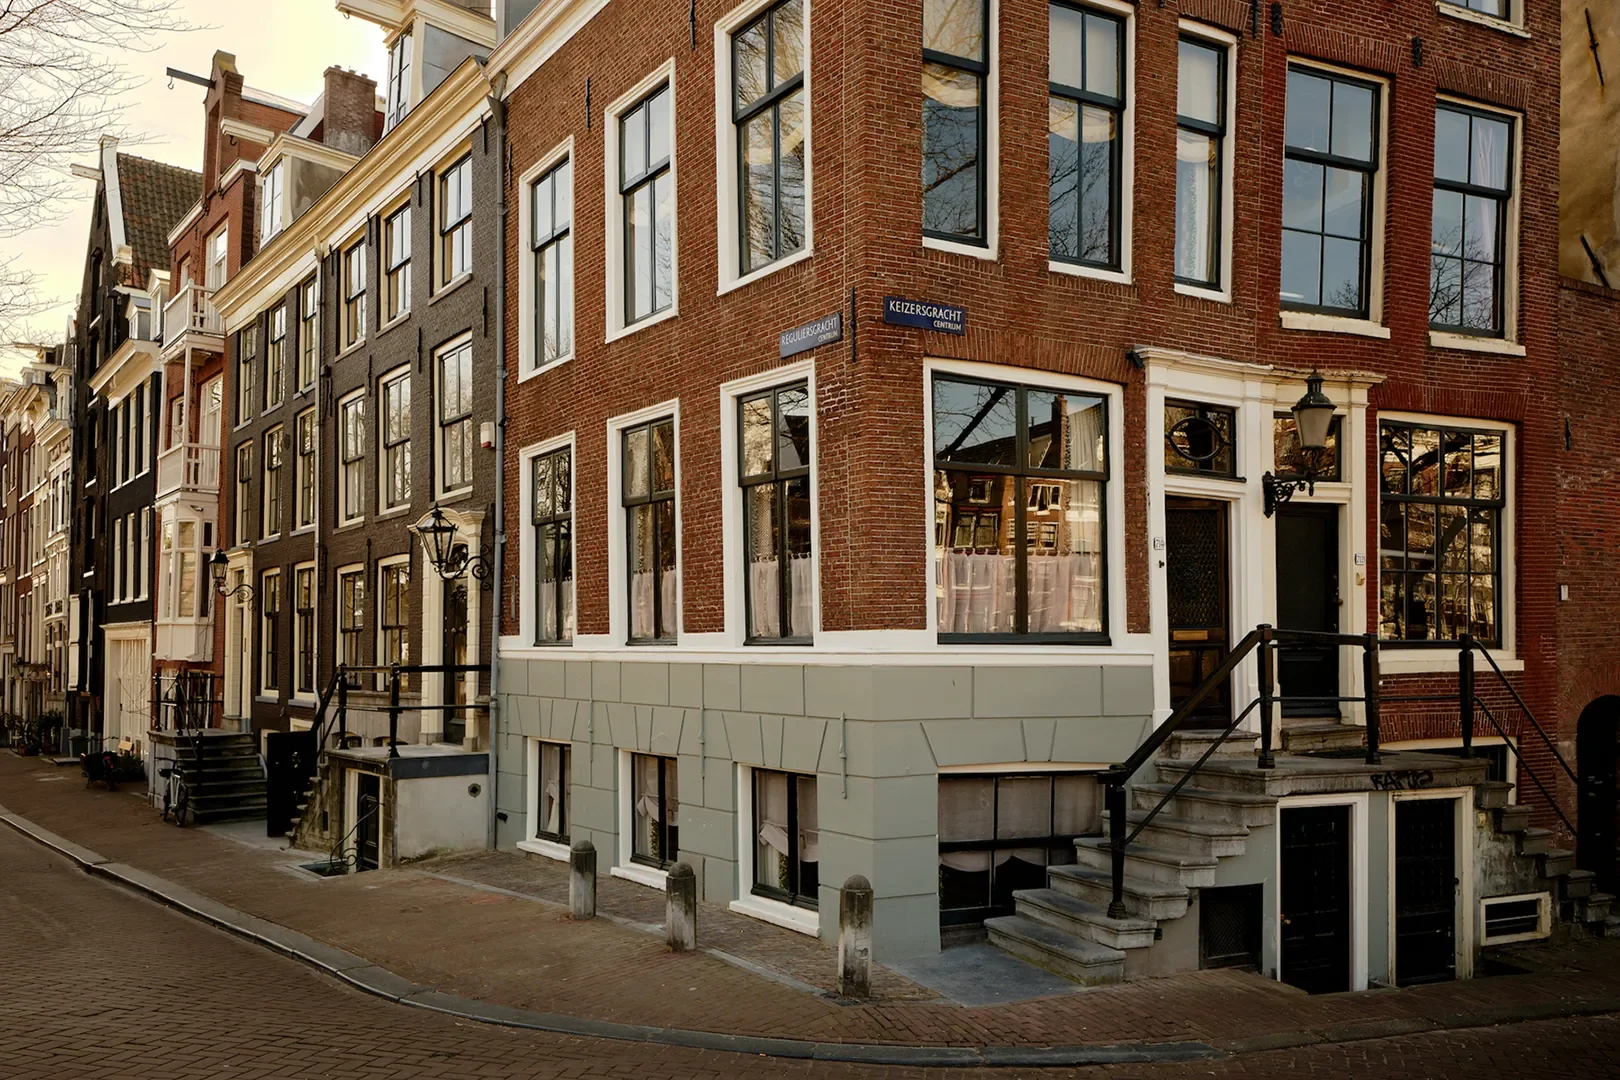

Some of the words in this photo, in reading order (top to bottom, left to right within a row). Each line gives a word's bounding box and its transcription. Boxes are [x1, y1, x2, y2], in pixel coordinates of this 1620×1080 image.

[889, 300, 962, 322] KEIZERSGRACHT
[781, 316, 837, 346] REGULIERSGRACHT
[933, 320, 962, 331] CENTRUM
[817, 330, 839, 343] CENTRUM
